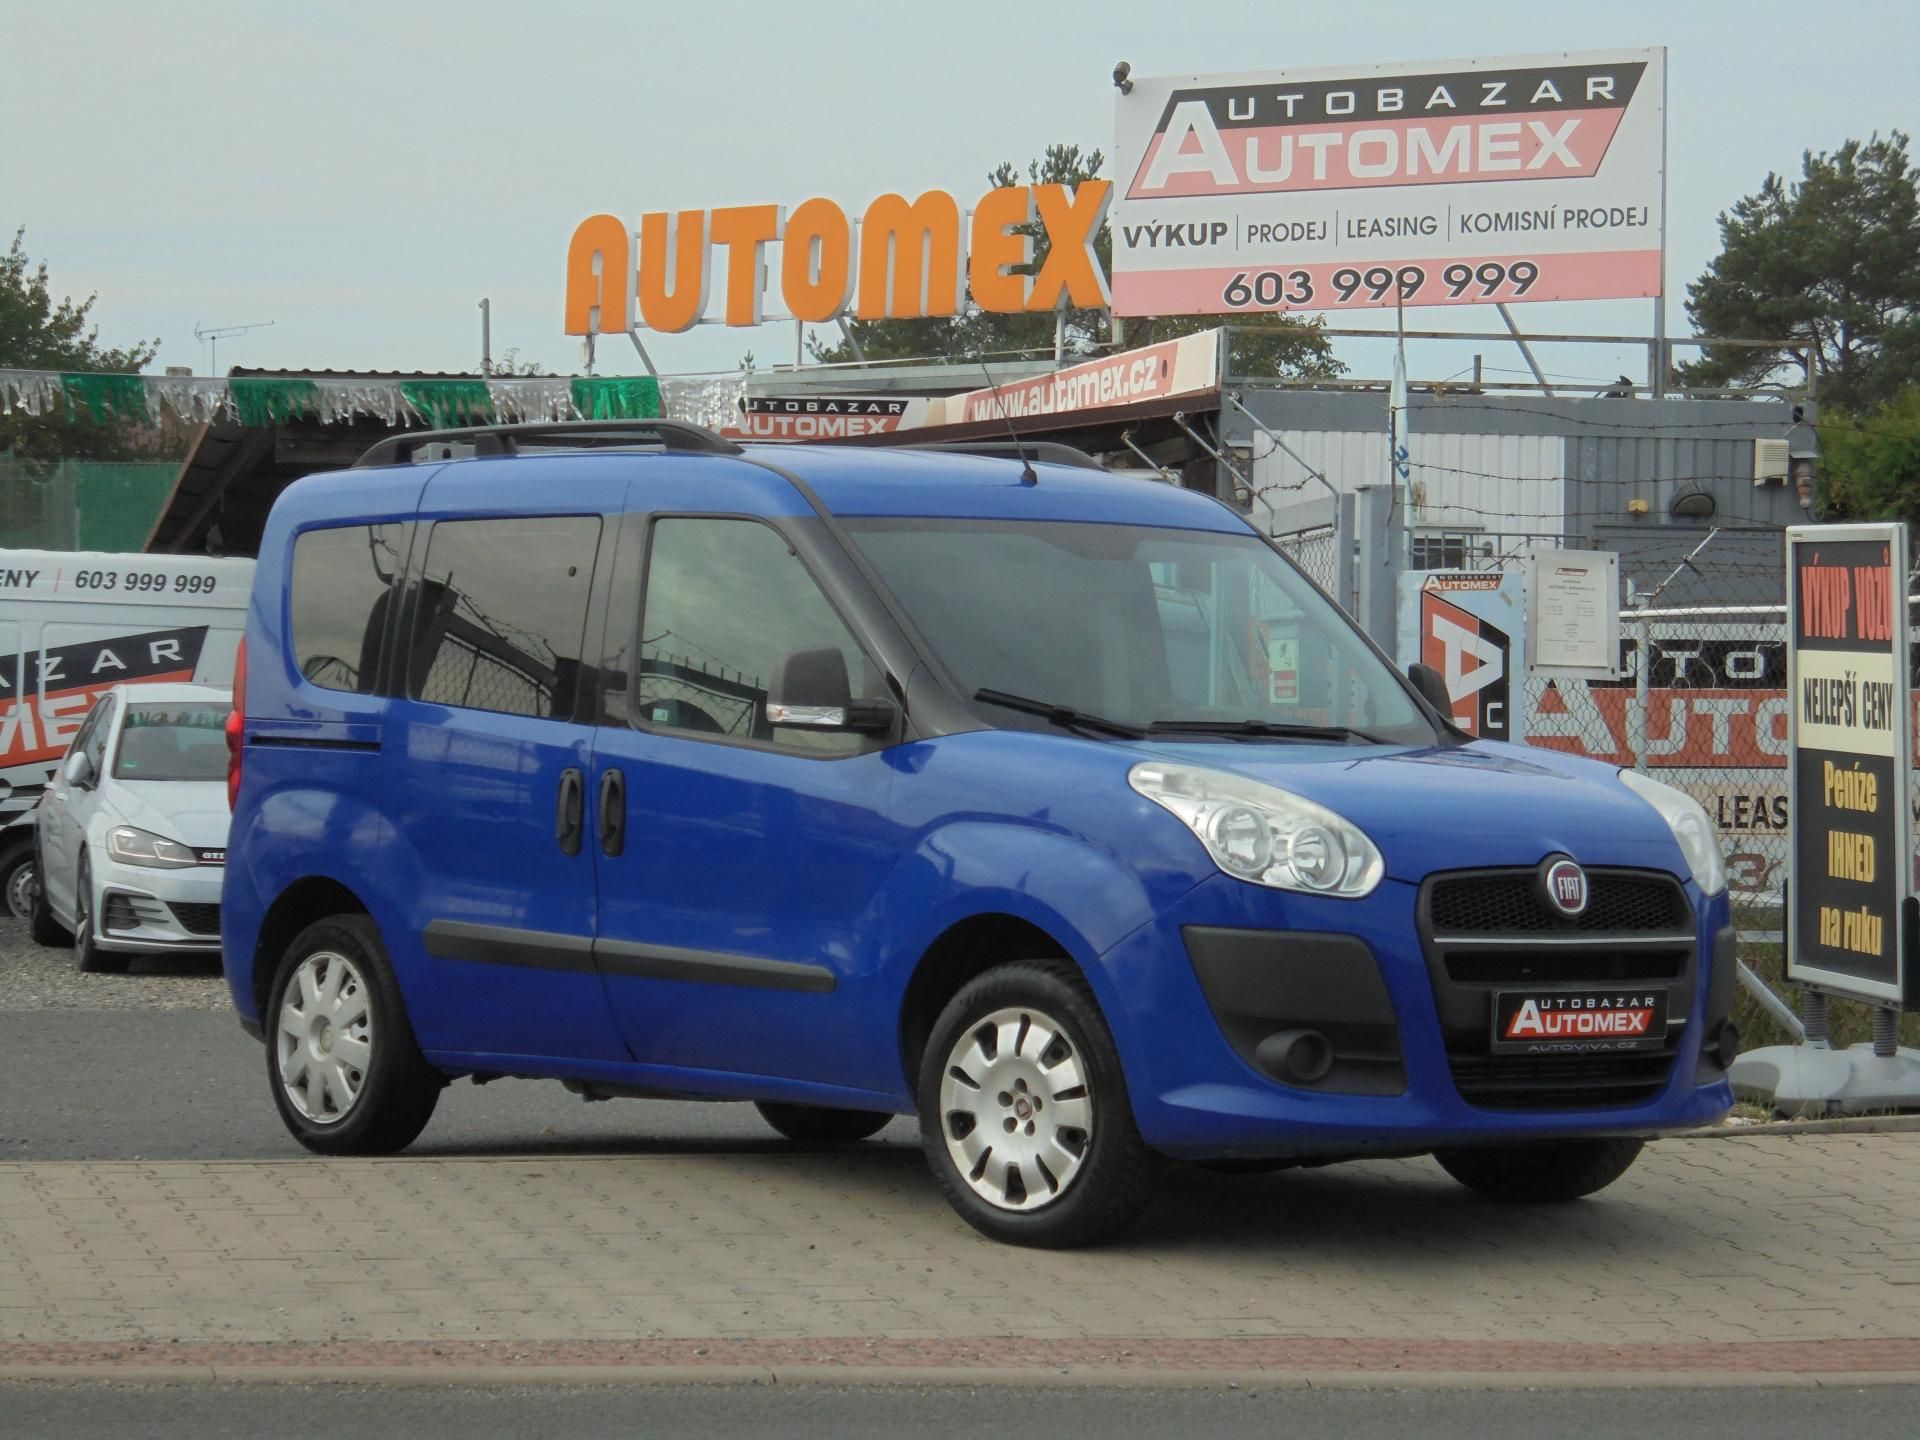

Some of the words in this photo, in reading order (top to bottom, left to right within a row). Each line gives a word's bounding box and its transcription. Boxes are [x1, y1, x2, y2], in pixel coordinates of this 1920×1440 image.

[1140, 99, 1581, 189] AUTOMEX
[1122, 217, 1228, 249] VÝKUP
[1247, 220, 1327, 243] PRODEJ
[1347, 215, 1438, 239] LEASING
[1460, 204, 1558, 234] KOMISNÍ
[1564, 206, 1648, 230] PRODEJ
[565, 180, 1113, 336] AUTOMEX
[1223, 270, 1314, 307] 603
[1332, 265, 1425, 302] 999
[1443, 260, 1538, 298] 999
[974, 355, 1157, 421] www.automex.cz
[75, 570, 117, 589] 603
[124, 572, 167, 592] 999
[174, 575, 216, 595] 999
[1423, 575, 1497, 590] AUTOMEX
[1802, 552, 1850, 640] VÝKUP
[1854, 546, 1893, 641] VOZŮ
[1803, 670, 1857, 728] NEJLEPŠÍ
[1862, 679, 1893, 731] CENY
[1824, 760, 1877, 813] Peníze
[1828, 830, 1875, 884] IHNED
[1557, 876, 1580, 901] FIAT
[1820, 906, 1841, 948] na
[1842, 905, 1882, 956] ruku
[1512, 999, 1644, 1034] AUTOMEX
[1528, 1041, 1638, 1052] AUTOVIVA.CZ
